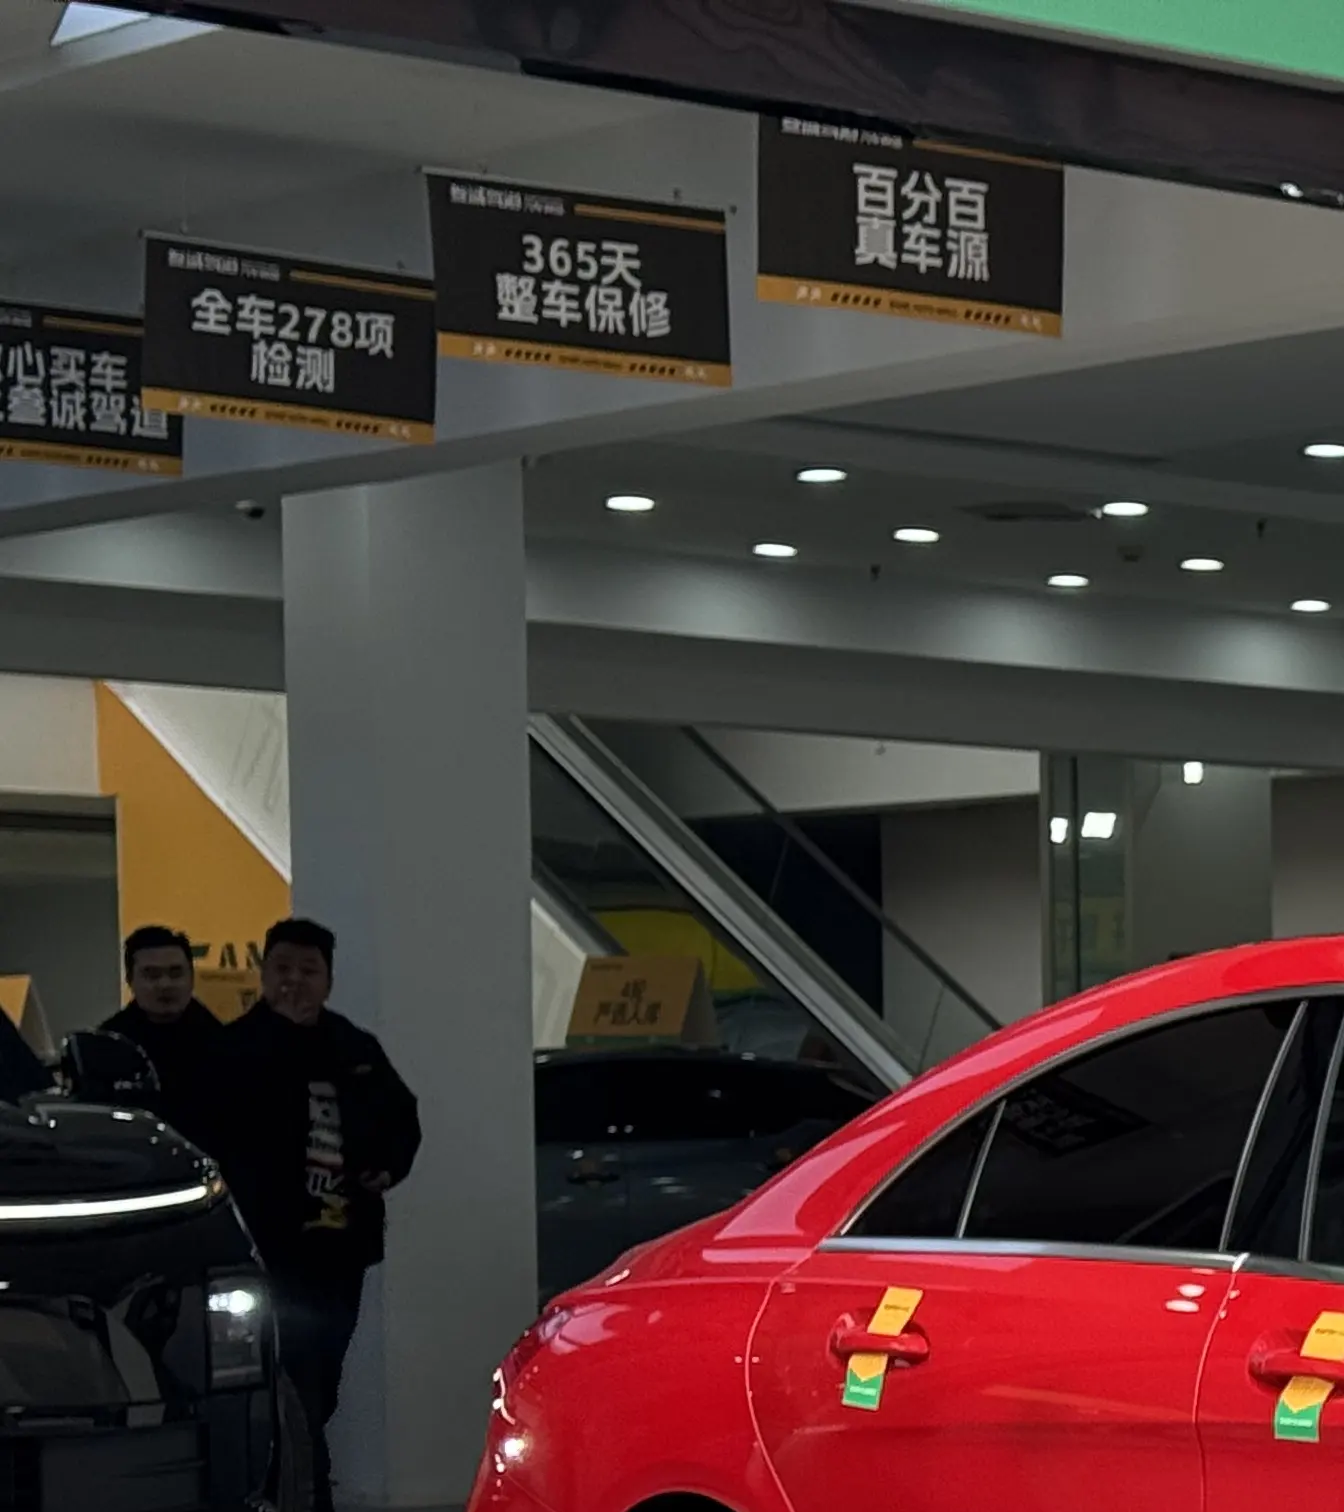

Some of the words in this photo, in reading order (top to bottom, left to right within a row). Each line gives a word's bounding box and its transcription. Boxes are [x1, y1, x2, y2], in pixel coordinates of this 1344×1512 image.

[853, 162, 989, 231] 百分百
[521, 233, 642, 288] 365天
[854, 215, 990, 282] 真车源
[191, 287, 395, 359] 全车278项
[496, 272, 671, 338] 整车保修
[0, 341, 128, 392] 心买车
[251, 339, 335, 393] 检测
[0, 384, 168, 440] 叁诚驾道
